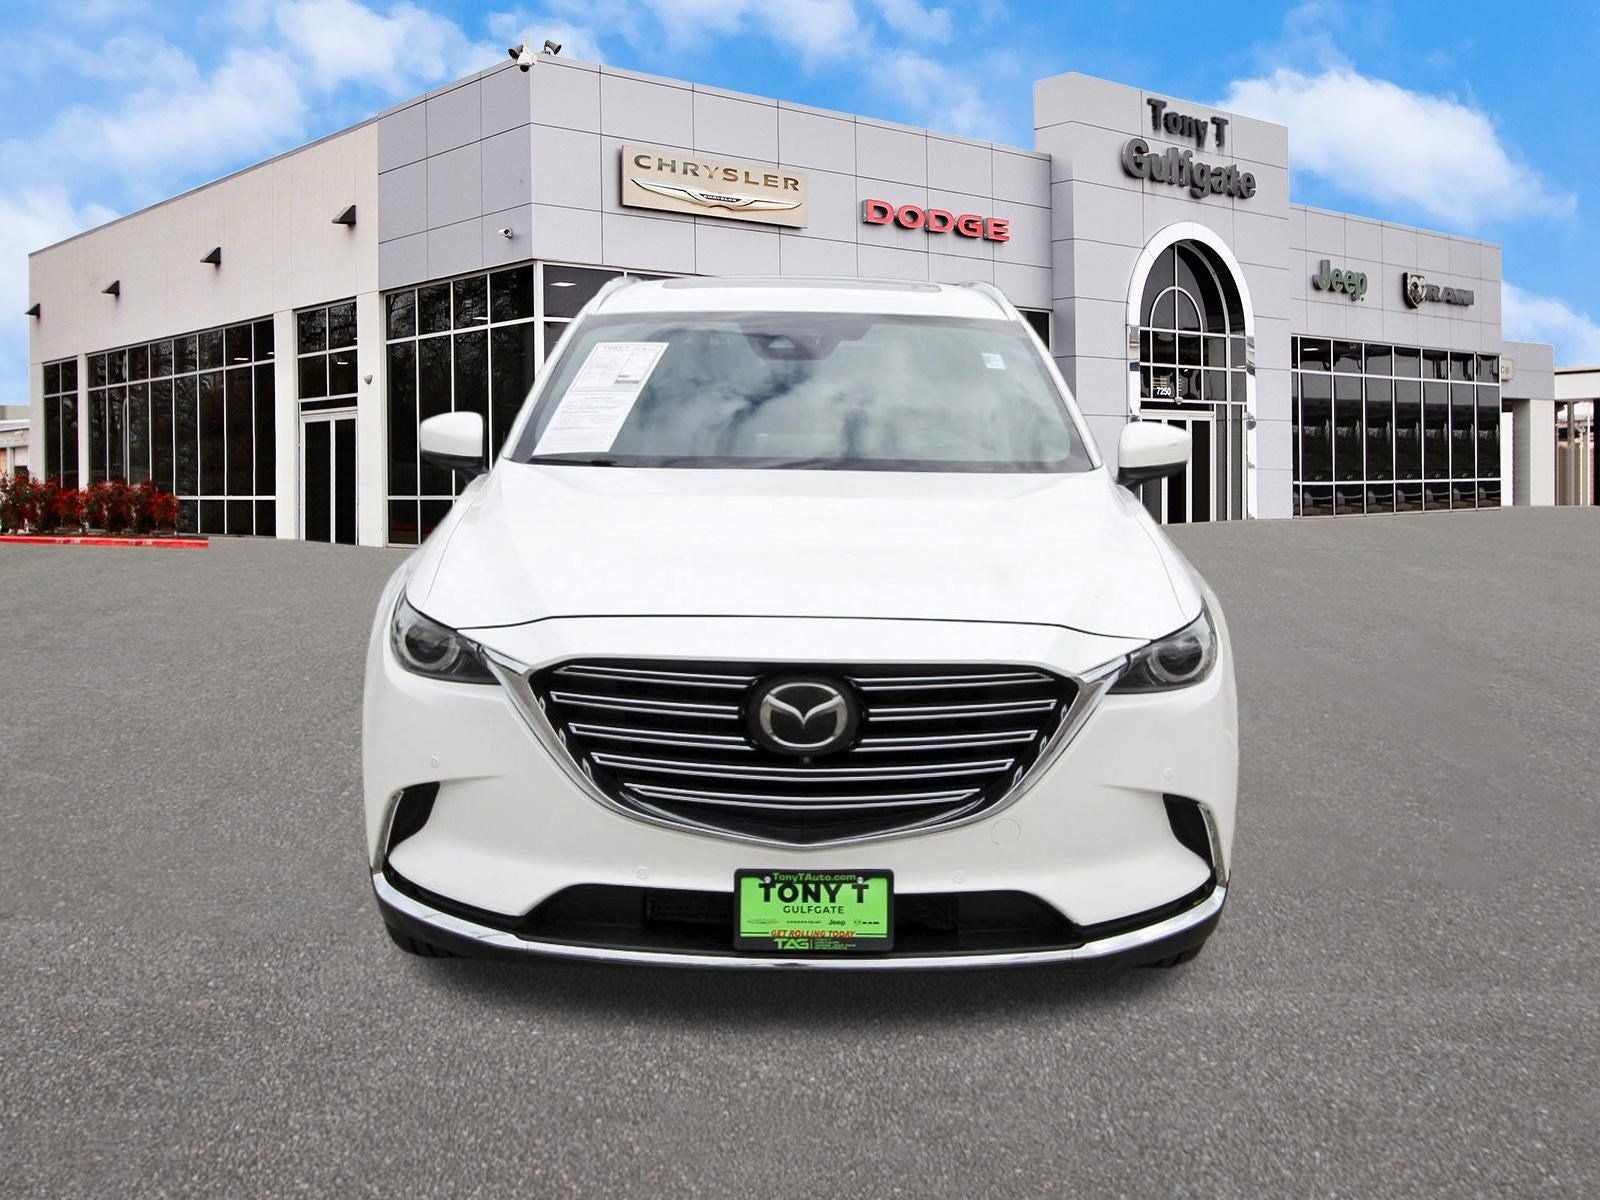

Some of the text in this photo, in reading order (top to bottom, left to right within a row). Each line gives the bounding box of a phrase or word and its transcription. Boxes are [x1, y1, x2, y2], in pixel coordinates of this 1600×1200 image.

[1146, 98, 1229, 148] Tony T
[632, 153, 801, 192] CHRYSLER
[1121, 138, 1256, 199] Gulfgate
[862, 197, 1011, 242] DODGE
[1312, 259, 1368, 302] Jeep
[1425, 284, 1475, 307] RAM
[758, 882, 869, 904] TONY T
[772, 872, 857, 883] TonyTAuto.com
[783, 905, 845, 914] GULFGATE
[771, 929, 856, 939] GET ROLLING TODAY
